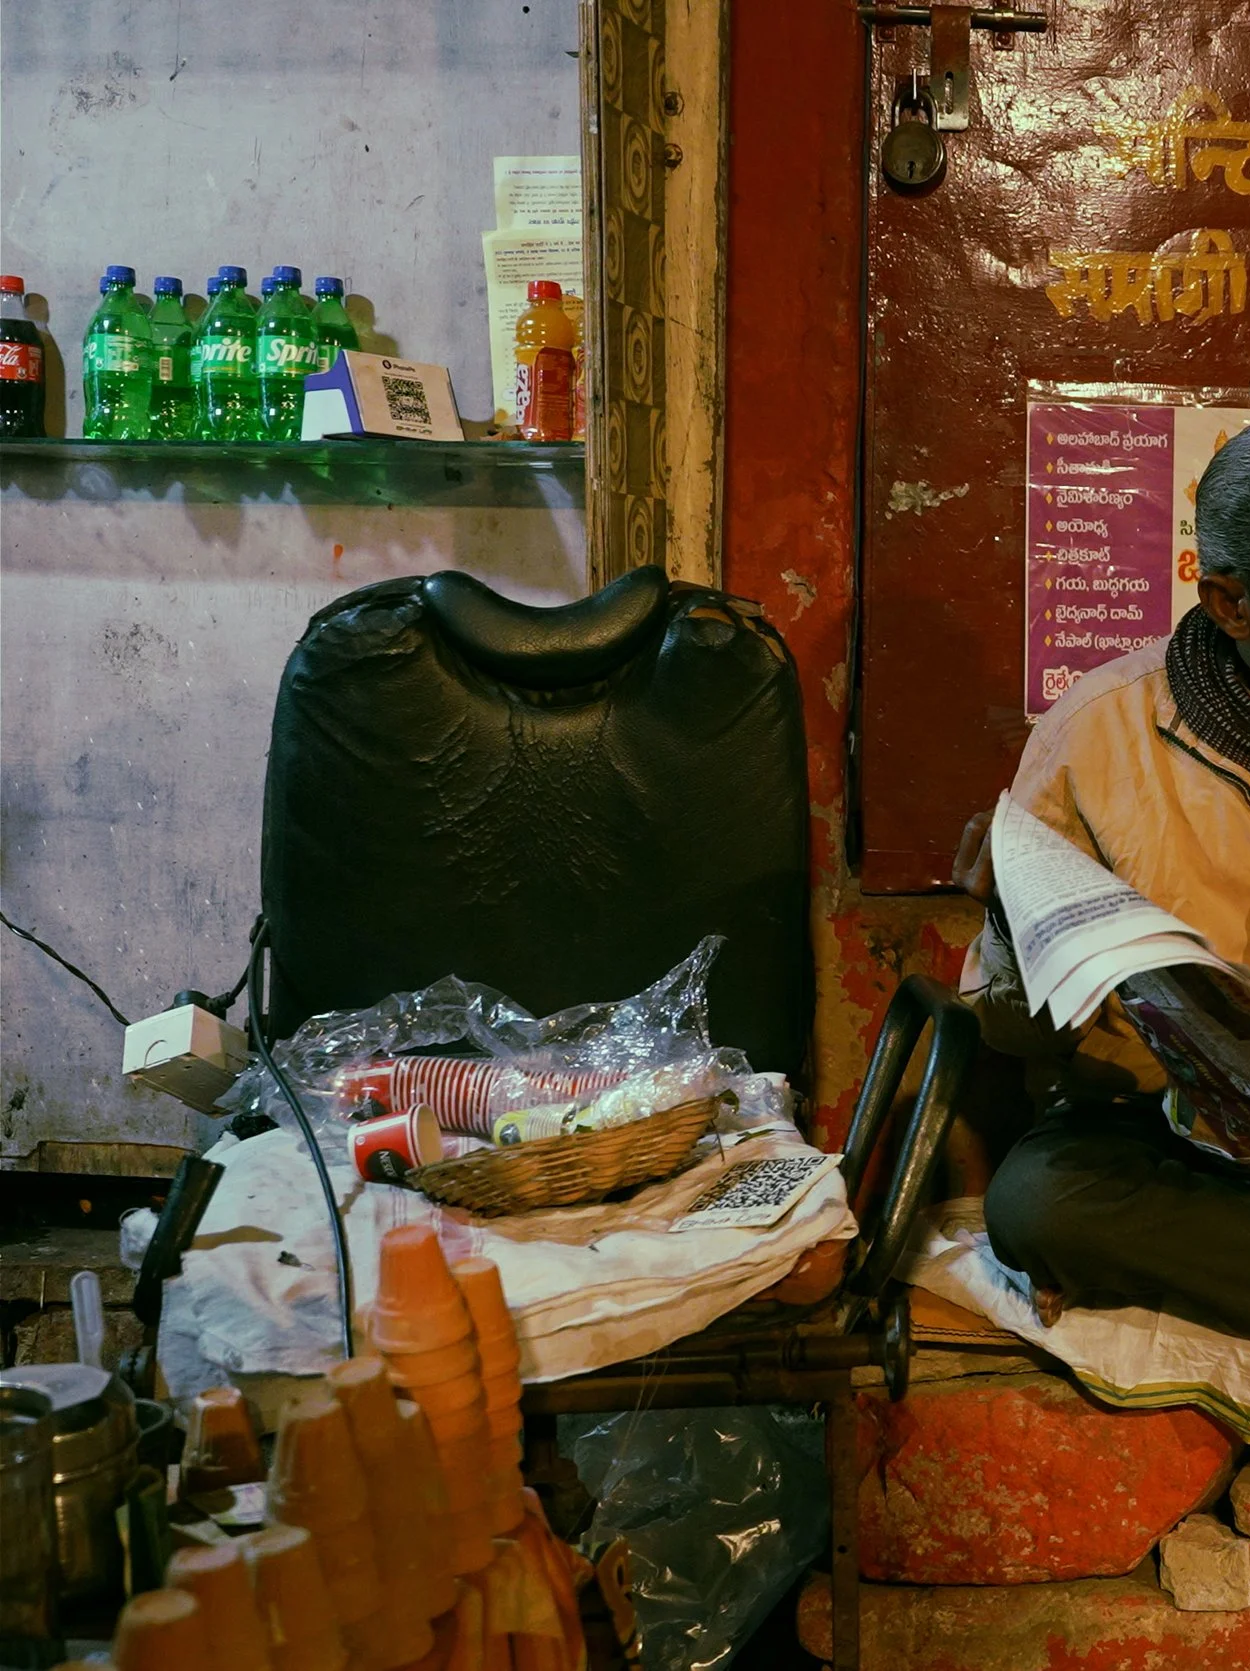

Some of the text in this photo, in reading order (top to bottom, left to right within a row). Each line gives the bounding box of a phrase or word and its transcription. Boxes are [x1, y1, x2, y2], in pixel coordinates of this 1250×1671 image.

[202, 338, 252, 362] prite
[1057, 430, 1168, 451] అలహాబాద్ ప్రయాగ
[1056, 518, 1109, 538] అయోధ్య
[1057, 546, 1111, 565] చిత్రకూట్
[1093, 577, 1150, 599] బుద్ధగయ
[1110, 604, 1143, 620] దామ్
[1055, 631, 1092, 648] నేపాల్
